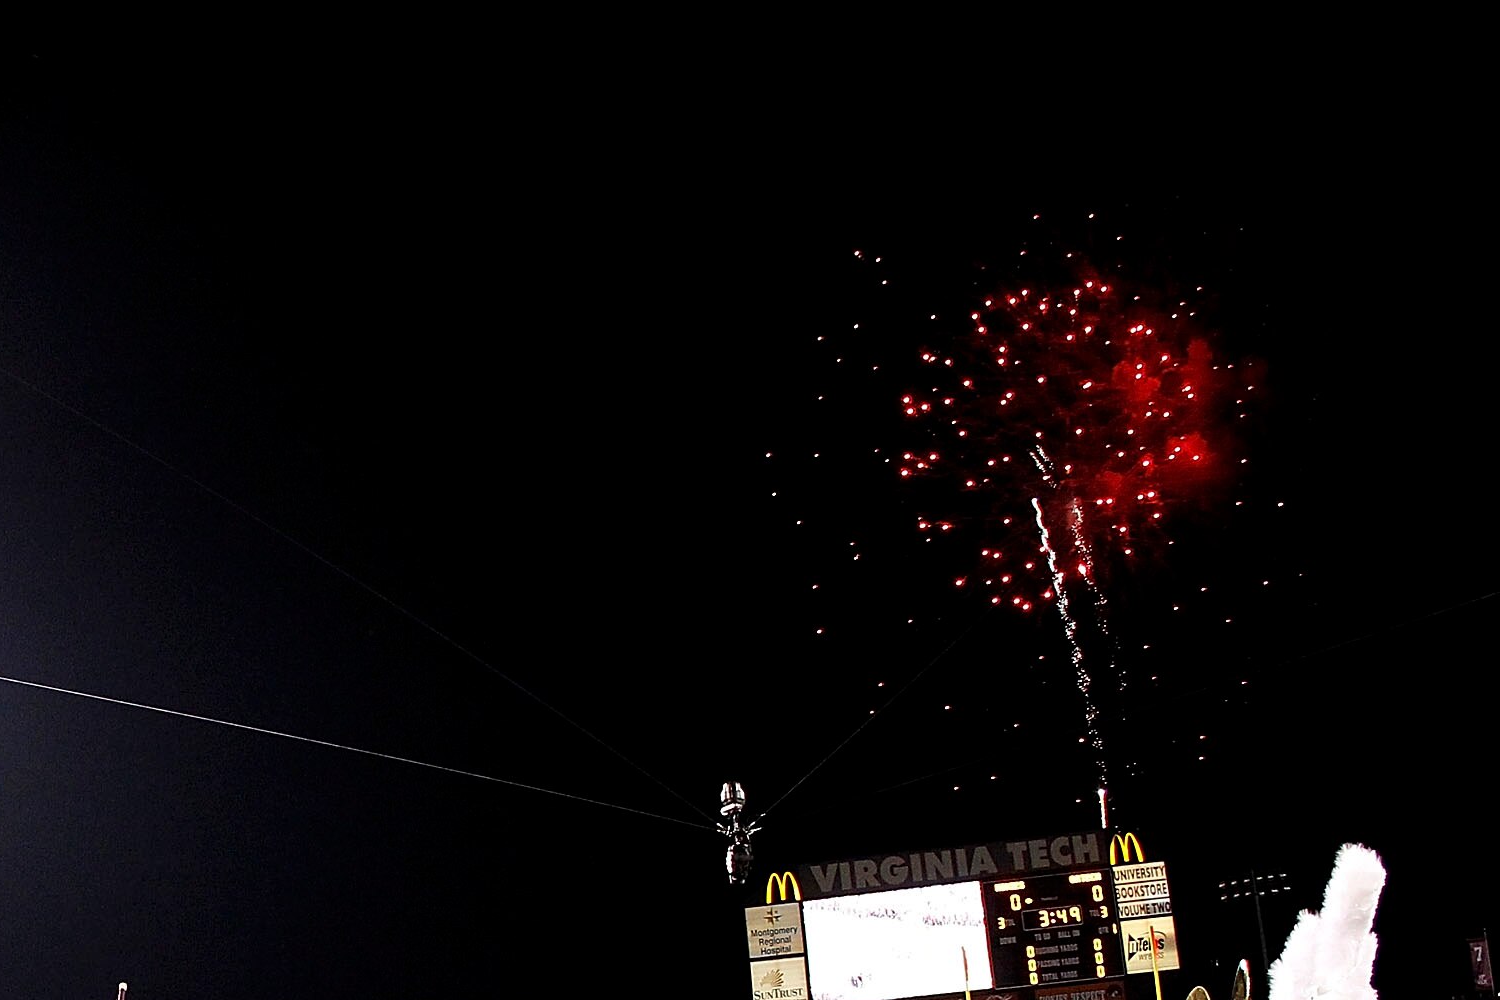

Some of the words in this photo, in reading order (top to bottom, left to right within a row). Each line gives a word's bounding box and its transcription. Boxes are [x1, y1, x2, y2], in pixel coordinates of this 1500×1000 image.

[810, 845, 998, 893] VIRGINIA
[1006, 833, 1100, 871] TECH
[1114, 865, 1165, 881] UNIVERSITY
[1091, 884, 1104, 902] 0
[1116, 883, 1168, 899] BOOKSTORE
[1009, 893, 1022, 911] 0
[1118, 902, 1150, 916] VOLUME
[1152, 901, 1171, 913] TWO
[1038, 906, 1081, 927] 3:49
[750, 926, 798, 938] Montgomery
[759, 936, 792, 947] Regional
[761, 945, 791, 956] Hospital
